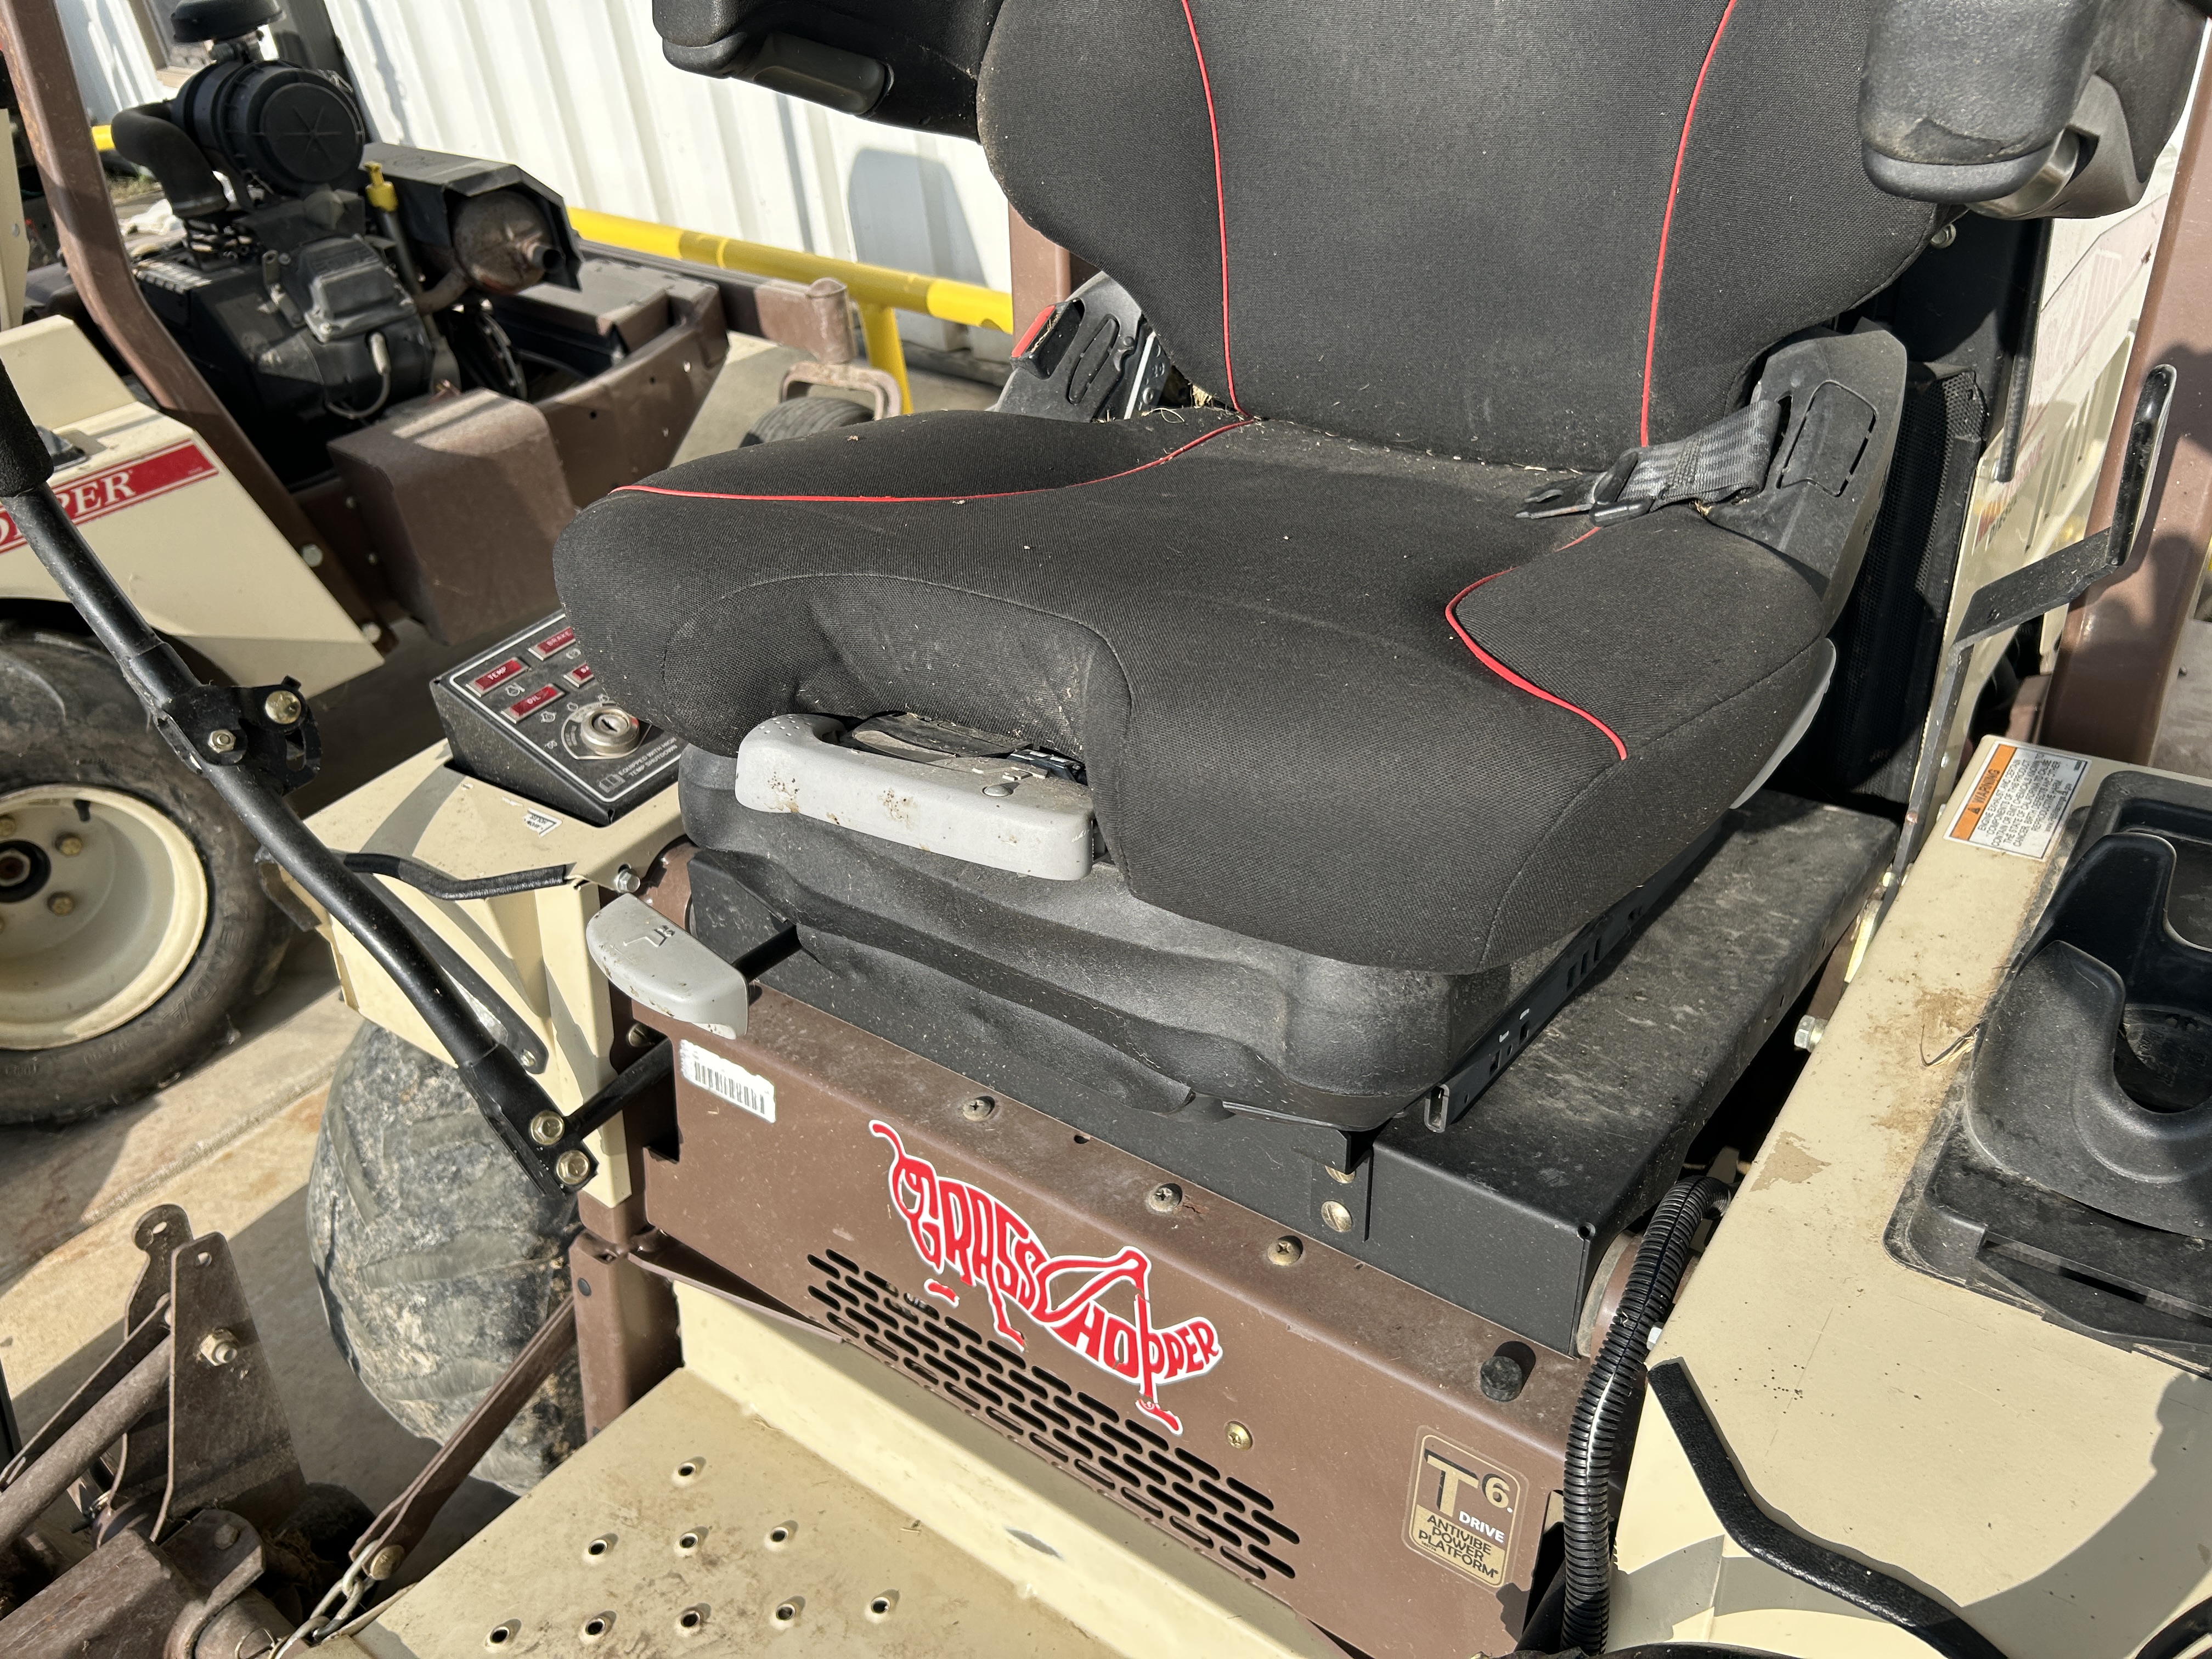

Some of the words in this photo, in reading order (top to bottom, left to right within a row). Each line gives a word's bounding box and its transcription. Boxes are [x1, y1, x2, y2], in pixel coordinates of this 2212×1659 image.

[546, 631, 572, 646] BRAKE
[487, 666, 506, 680] TEMP
[527, 695, 541, 704] OIL
[618, 755, 647, 776] EQUIPPED
[646, 746, 662, 758] WITH
[661, 737, 676, 748] HIGH
[628, 764, 645, 776] TEMP
[645, 744, 678, 767] SHUTDOWN
[1972, 768, 2000, 804] WARNING
[881, 1144, 1223, 1396] GRASSHOPPER
[1427, 1514, 1492, 1556] ANTIVIBE
[1459, 1510, 1505, 1543] DRIVE
[1432, 1526, 1484, 1562] POWER
